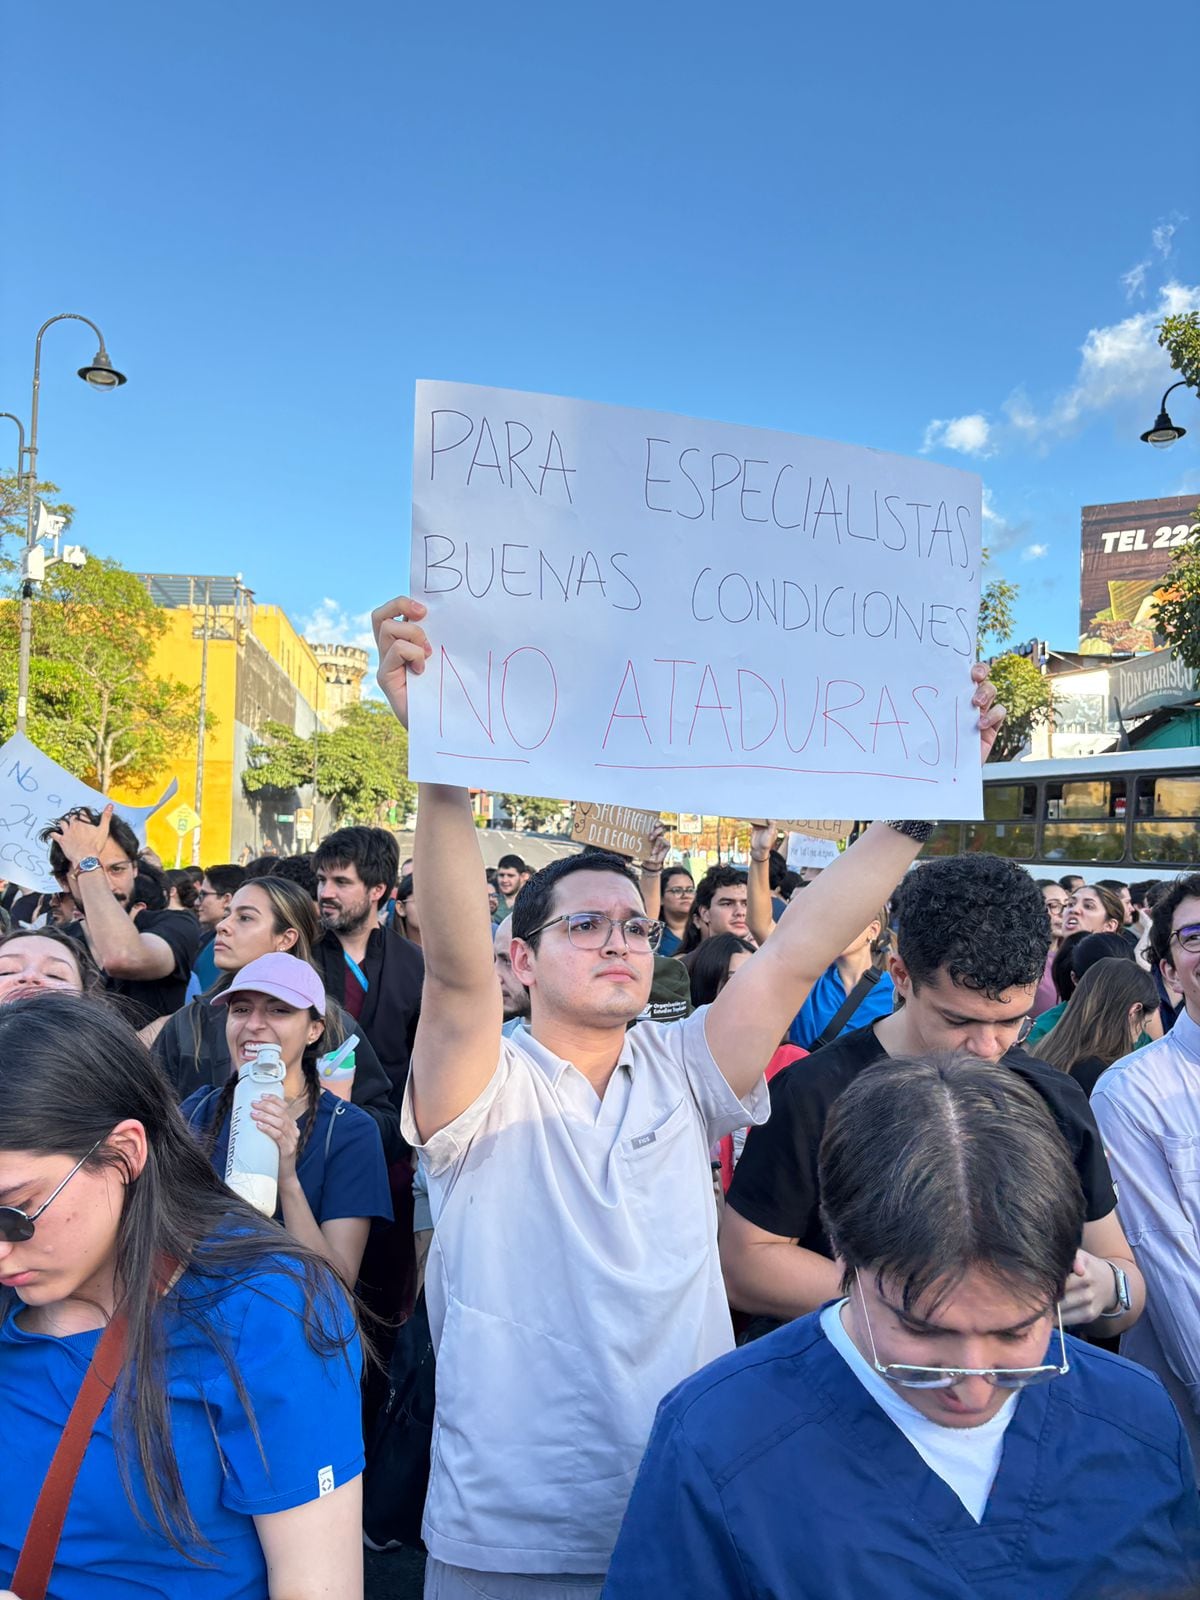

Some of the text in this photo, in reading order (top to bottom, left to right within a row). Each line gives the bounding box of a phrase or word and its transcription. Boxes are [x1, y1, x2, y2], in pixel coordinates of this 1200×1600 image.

[431, 409, 577, 504] PARA
[423, 534, 642, 611] BUENAS
[1101, 529, 1149, 554] TEL
[439, 645, 960, 783] NO ATADURAS!
[1119, 667, 1142, 711] DON
[588, 823, 643, 853] DERECHOS
[225, 1105, 243, 1178] lululemon
